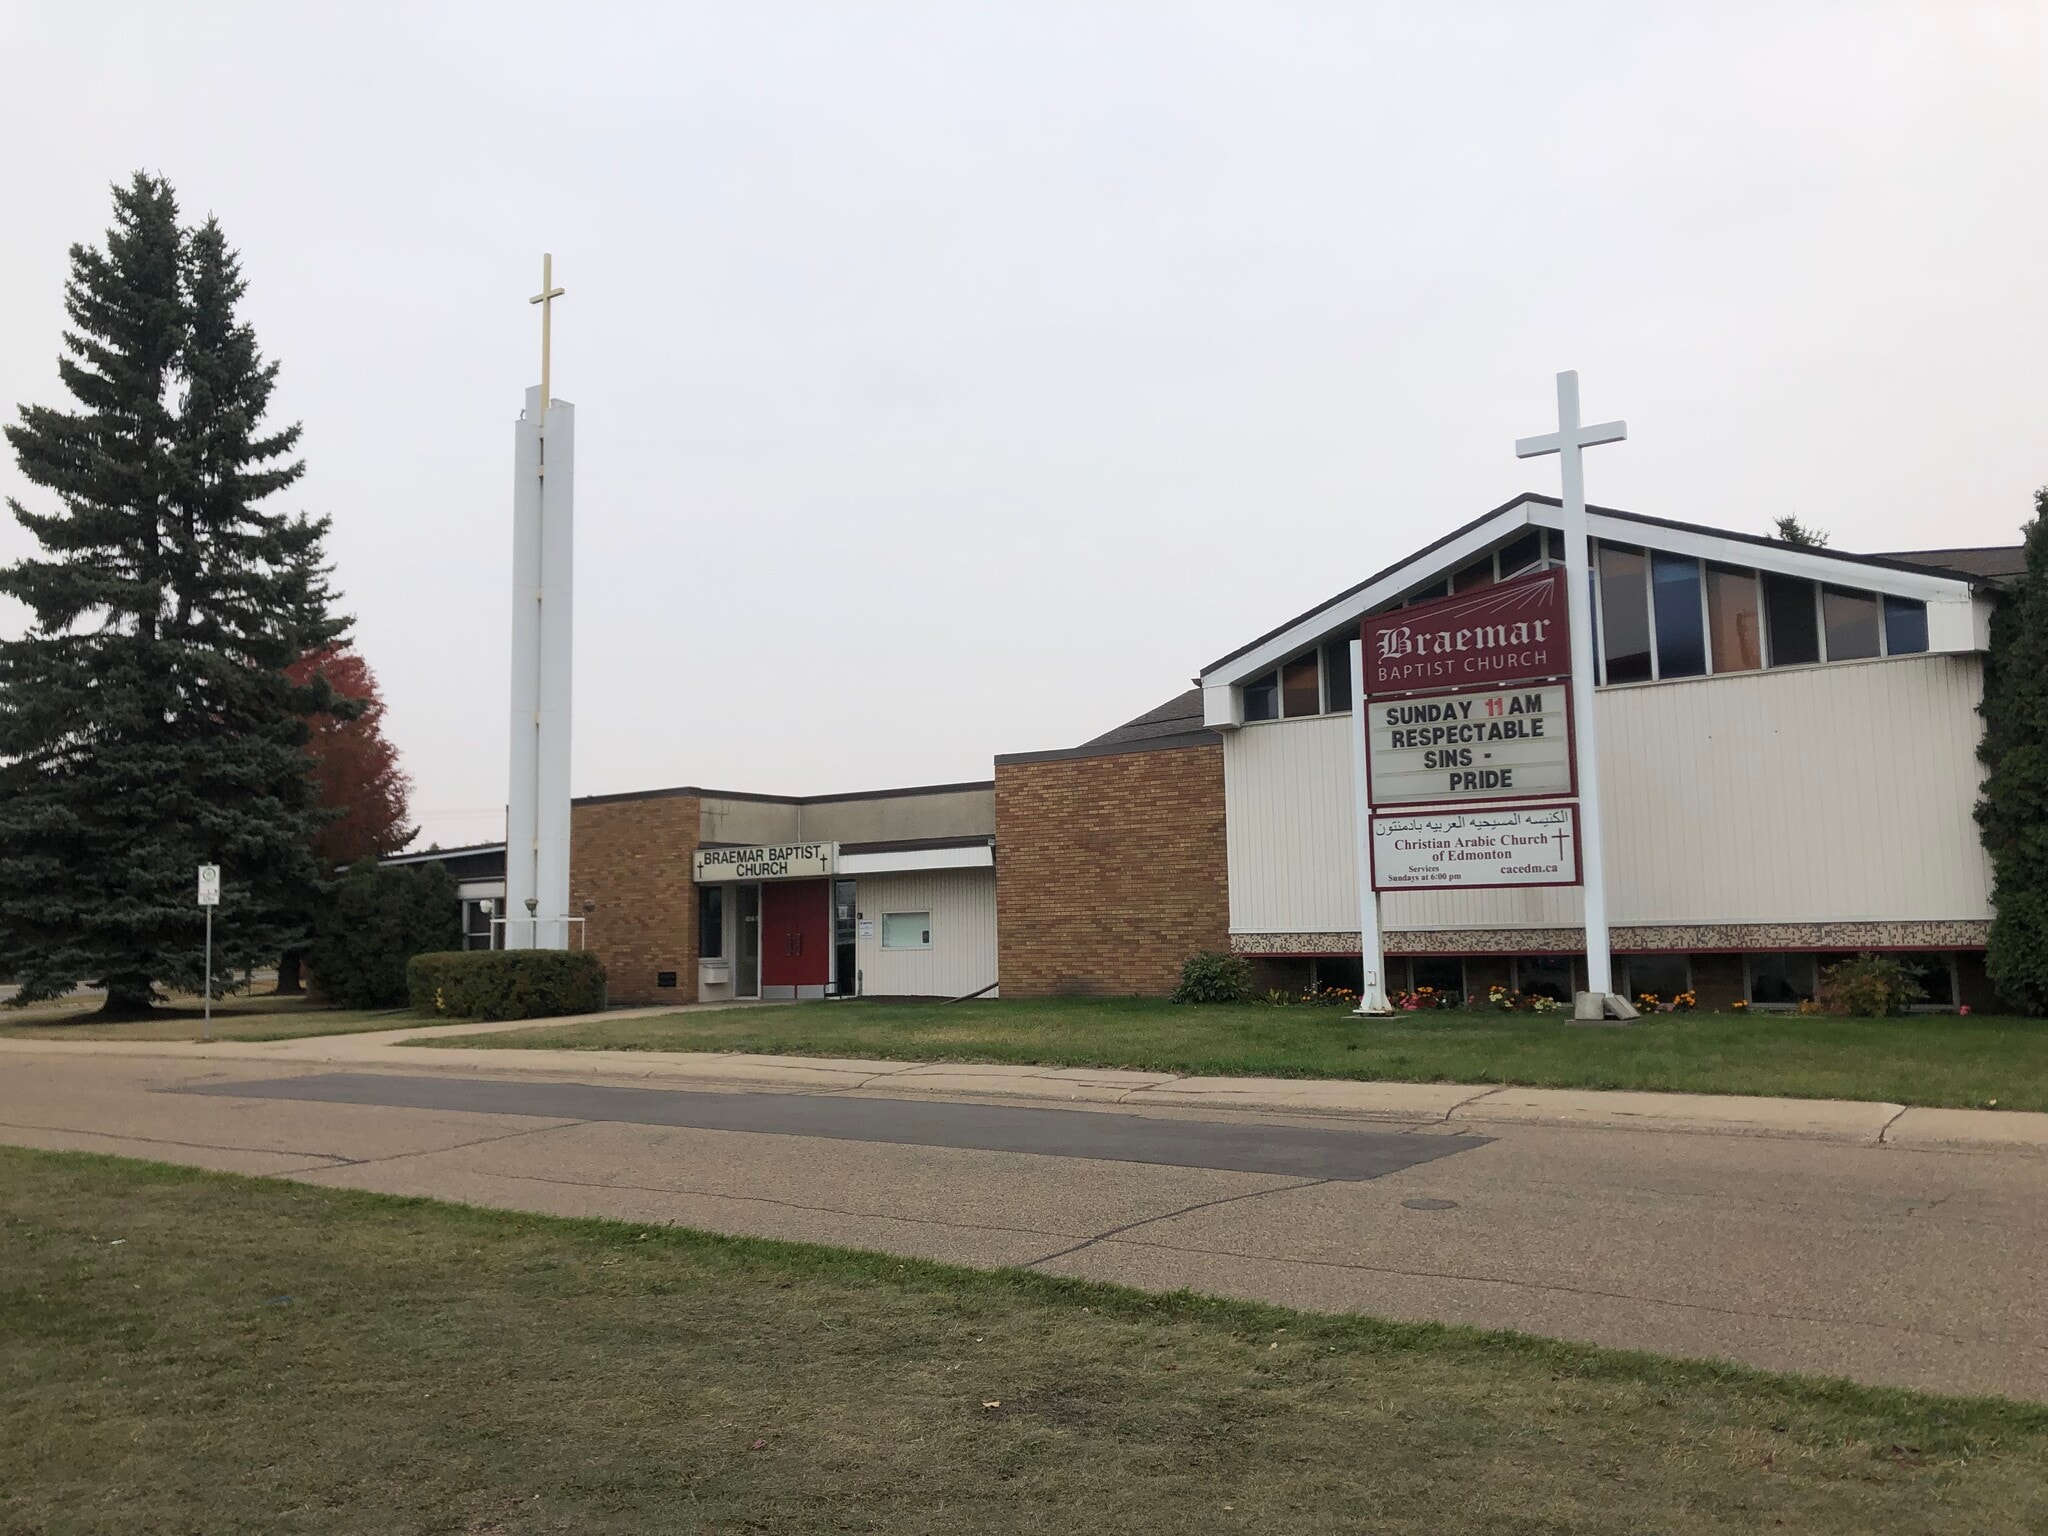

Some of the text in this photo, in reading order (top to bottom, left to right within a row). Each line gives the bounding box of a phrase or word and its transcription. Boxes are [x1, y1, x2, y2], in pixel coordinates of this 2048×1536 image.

[1376, 618, 1551, 665] Braemar
[1378, 650, 1547, 681] BAPTIST CHURCH
[1386, 693, 1542, 726] SUNDAY 11 AM
[1391, 718, 1545, 748] RESPECTABLE
[1424, 748, 1473, 769] SINS
[1449, 768, 1513, 791] PRIDE
[1394, 833, 1548, 851] Christian Arabic Church
[704, 845, 821, 865] BRAEMAR BAPTIST
[1432, 850, 1512, 862] of Edmonton
[736, 861, 788, 877] CHURCH
[1388, 874, 1420, 883] Sundays
[1430, 872, 1447, 880] 6:00
[1449, 874, 1462, 882] pm
[1408, 865, 1440, 873] Services
[1500, 864, 1558, 875] cacedm.ca
